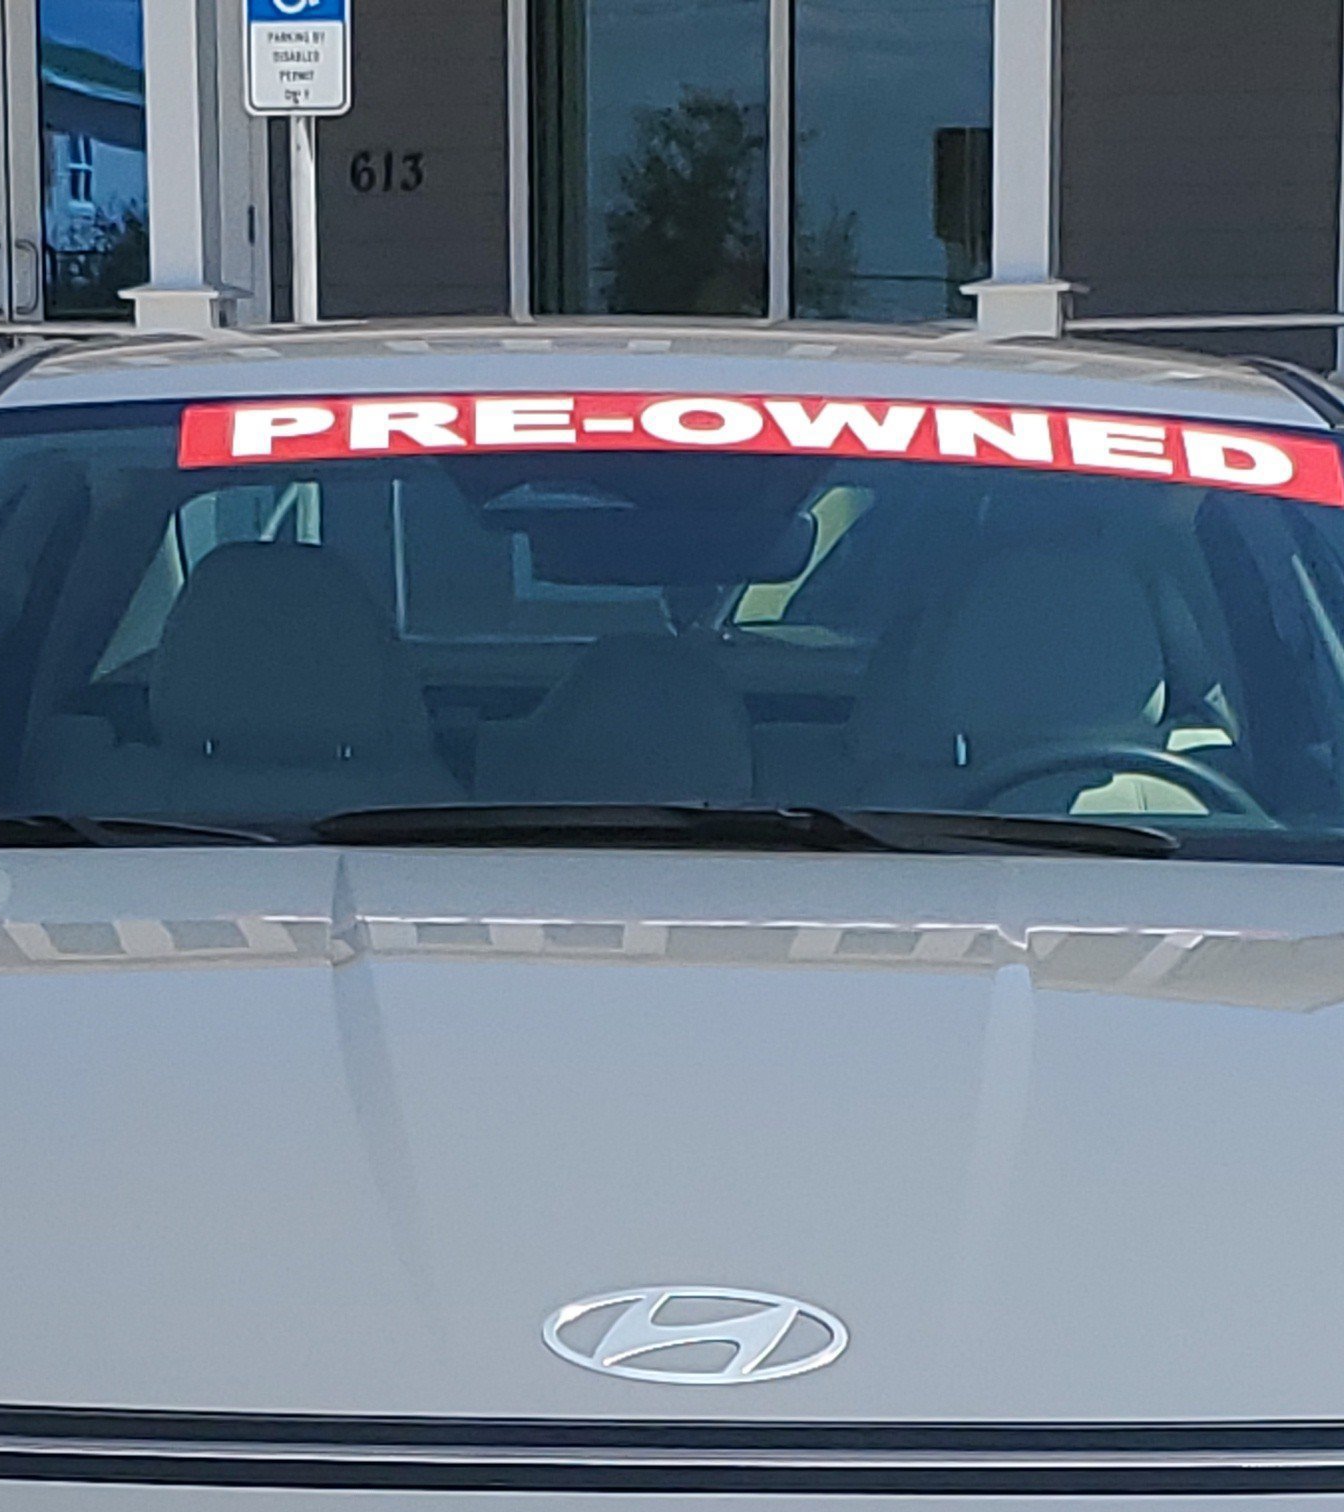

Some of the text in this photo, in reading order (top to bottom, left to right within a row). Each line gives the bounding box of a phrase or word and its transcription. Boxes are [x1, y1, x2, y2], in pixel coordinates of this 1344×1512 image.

[268, 31, 309, 43] PARKING
[273, 51, 319, 62] DISABLED
[350, 151, 423, 192] 613
[229, 397, 1296, 486] PRE-OWNED
